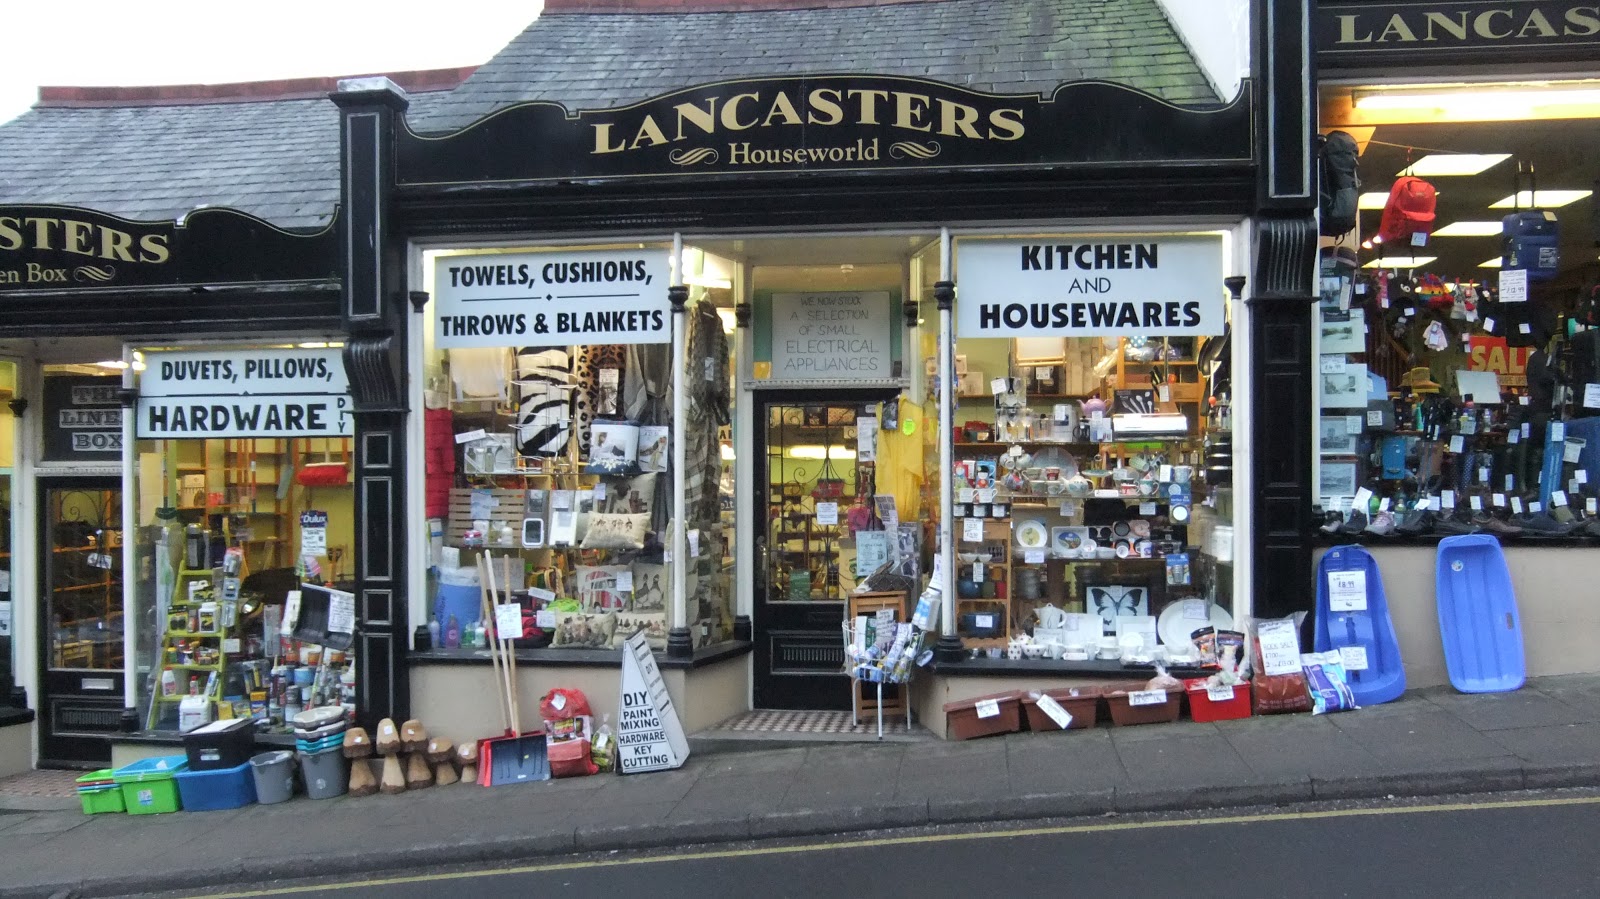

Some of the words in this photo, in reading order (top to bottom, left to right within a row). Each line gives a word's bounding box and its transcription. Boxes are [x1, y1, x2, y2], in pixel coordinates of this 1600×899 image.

[1335, 6, 1600, 44] LANCAS
[590, 88, 1026, 155] LANCASTERS
[729, 138, 880, 165] Houseworld
[0, 216, 169, 264] STERS
[1021, 243, 1158, 271] KITCHEN
[26, 262, 67, 283] Box
[449, 263, 535, 289] TOWELS,
[542, 260, 653, 286] CUSHIONS,
[1068, 277, 1111, 294] AND
[801, 297, 815, 305] WE
[817, 297, 835, 305] NOW
[838, 296, 862, 305] STOCK
[440, 312, 527, 336] THROWS
[533, 313, 549, 334] &
[556, 309, 664, 333] BLANKETS
[790, 311, 799, 320] A
[807, 309, 869, 321] SELECTION
[980, 301, 1201, 329] HOUSEWARES
[799, 324, 813, 335] OF
[817, 324, 861, 335] SMALL
[786, 339, 879, 354] ELECTRICAL
[161, 359, 238, 384] DUVETS,
[244, 357, 333, 382] PILLOWS,
[784, 357, 878, 371] APPLIANCES
[61, 410, 122, 426] LINE
[150, 404, 328, 432] HARDWARE
[74, 433, 123, 449] BOX
[303, 514, 326, 523] Dulux
[623, 691, 648, 706] DIY
[623, 708, 654, 720] PAINT
[620, 718, 660, 730] MIXING
[619, 731, 665, 744] HARDWARE
[634, 745, 653, 755] KEY
[623, 754, 669, 767] CUTTING
